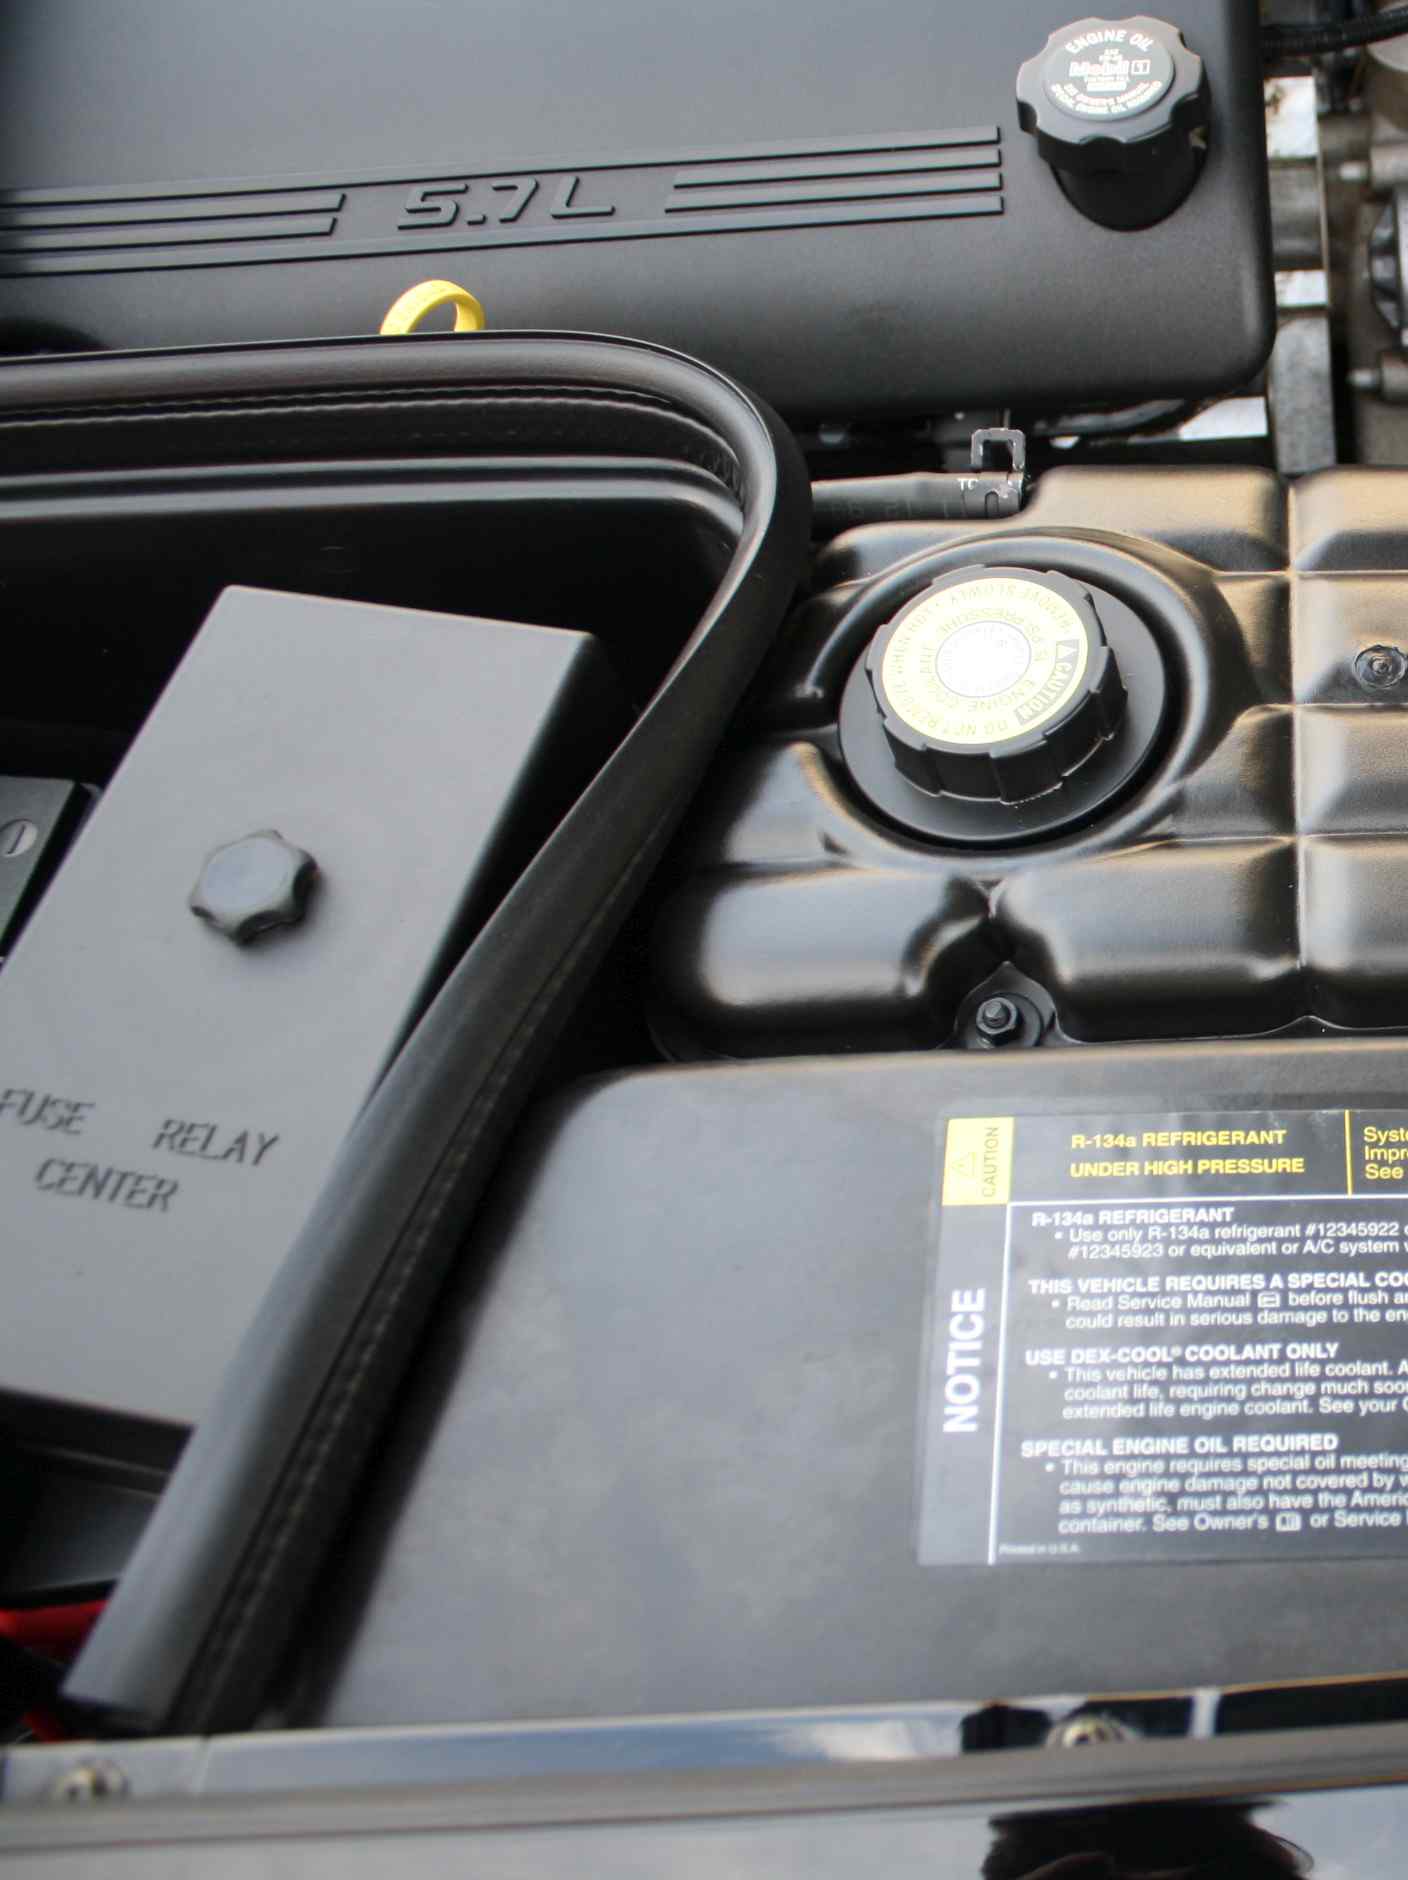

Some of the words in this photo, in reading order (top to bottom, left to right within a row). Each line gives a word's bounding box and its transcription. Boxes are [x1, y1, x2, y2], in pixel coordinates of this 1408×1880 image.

[1064, 29, 1127, 54] ENGINE
[1128, 33, 1154, 52] OIL
[397, 175, 616, 231] 5.7L
[1016, 661, 1074, 724] CAUTION
[0, 1088, 96, 1135] FUSE
[151, 1118, 280, 1166] RELAY
[1070, 1132, 1137, 1148] R-134a
[1142, 1130, 1285, 1148] REFRIGERANT
[981, 1126, 1000, 1198] CAUTION
[1068, 1160, 1140, 1177] UNDER
[1143, 1160, 1194, 1176] HIGH
[1196, 1157, 1306, 1175] PRESSURE
[1364, 1164, 1404, 1179] See
[35, 1157, 180, 1213] CENTER
[1030, 1210, 1094, 1226] R-134a
[1098, 1207, 1235, 1225] REFRIGERANT
[1068, 1226, 1103, 1241] Use
[1106, 1225, 1144, 1244] only
[1147, 1224, 1210, 1240] R-134a
[1214, 1222, 1301, 1242] refrigerant
[1304, 1221, 1400, 1237] #12345922
[1066, 1242, 1164, 1259] #12345923
[1302, 1239, 1335, 1254] A/C
[1338, 1238, 1400, 1257] system
[1026, 1278, 1074, 1294] THIS
[1076, 1276, 1160, 1293] VEHICLE
[1164, 1274, 1267, 1292] REQUIRES
[1268, 1273, 1284, 1289] A
[1287, 1272, 1371, 1289] SPECIAL
[1186, 1292, 1251, 1308] Manual
[1288, 1290, 1344, 1306] before
[1347, 1289, 1389, 1305] flush
[1256, 1308, 1328, 1328] damage
[1331, 1308, 1350, 1323] to
[1352, 1308, 1381, 1323] the
[943, 1287, 986, 1432] NOTICE
[1024, 1349, 1066, 1366] USE
[1184, 1344, 1280, 1362] COOLANT
[1285, 1342, 1339, 1360] ONLY
[1324, 1360, 1393, 1377] coolant.
[1320, 1379, 1370, 1395] much
[1318, 1398, 1355, 1414] See
[1357, 1400, 1398, 1417] your
[1020, 1439, 1109, 1458] SPECIAL
[1112, 1438, 1190, 1456] ENGINE
[1193, 1437, 1228, 1454] OIL
[1232, 1434, 1340, 1454] REQUIRED
[1333, 1510, 1402, 1527] Service
